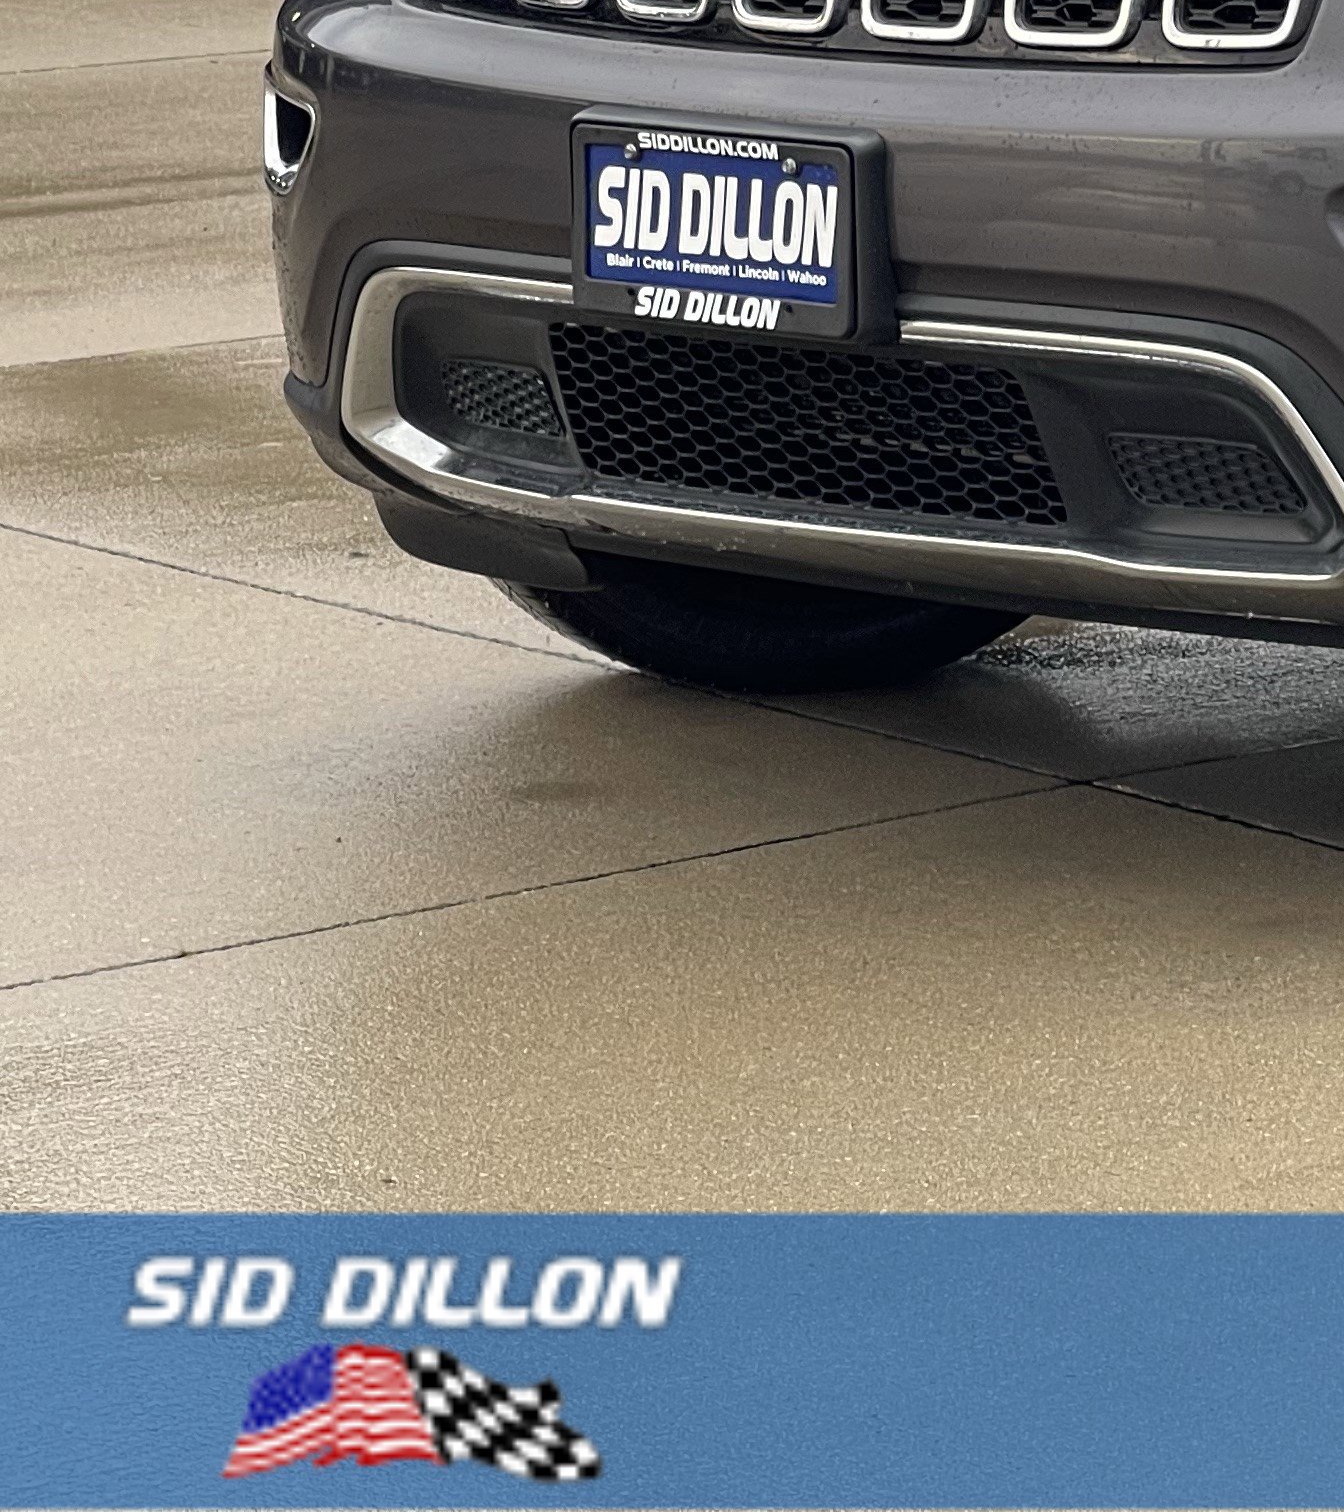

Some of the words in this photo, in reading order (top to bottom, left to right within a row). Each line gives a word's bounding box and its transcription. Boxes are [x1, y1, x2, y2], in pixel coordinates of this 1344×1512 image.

[637, 132, 779, 160] SIDDILLON.COM
[594, 165, 670, 252] SID
[678, 173, 838, 268] DILLON
[606, 253, 634, 267] Blair
[643, 256, 674, 271] Crete
[682, 260, 730, 276] Fremont
[739, 265, 780, 281] Lincoln
[787, 270, 827, 286] Wahoo
[635, 286, 681, 319] SID
[684, 291, 781, 330] DILLON
